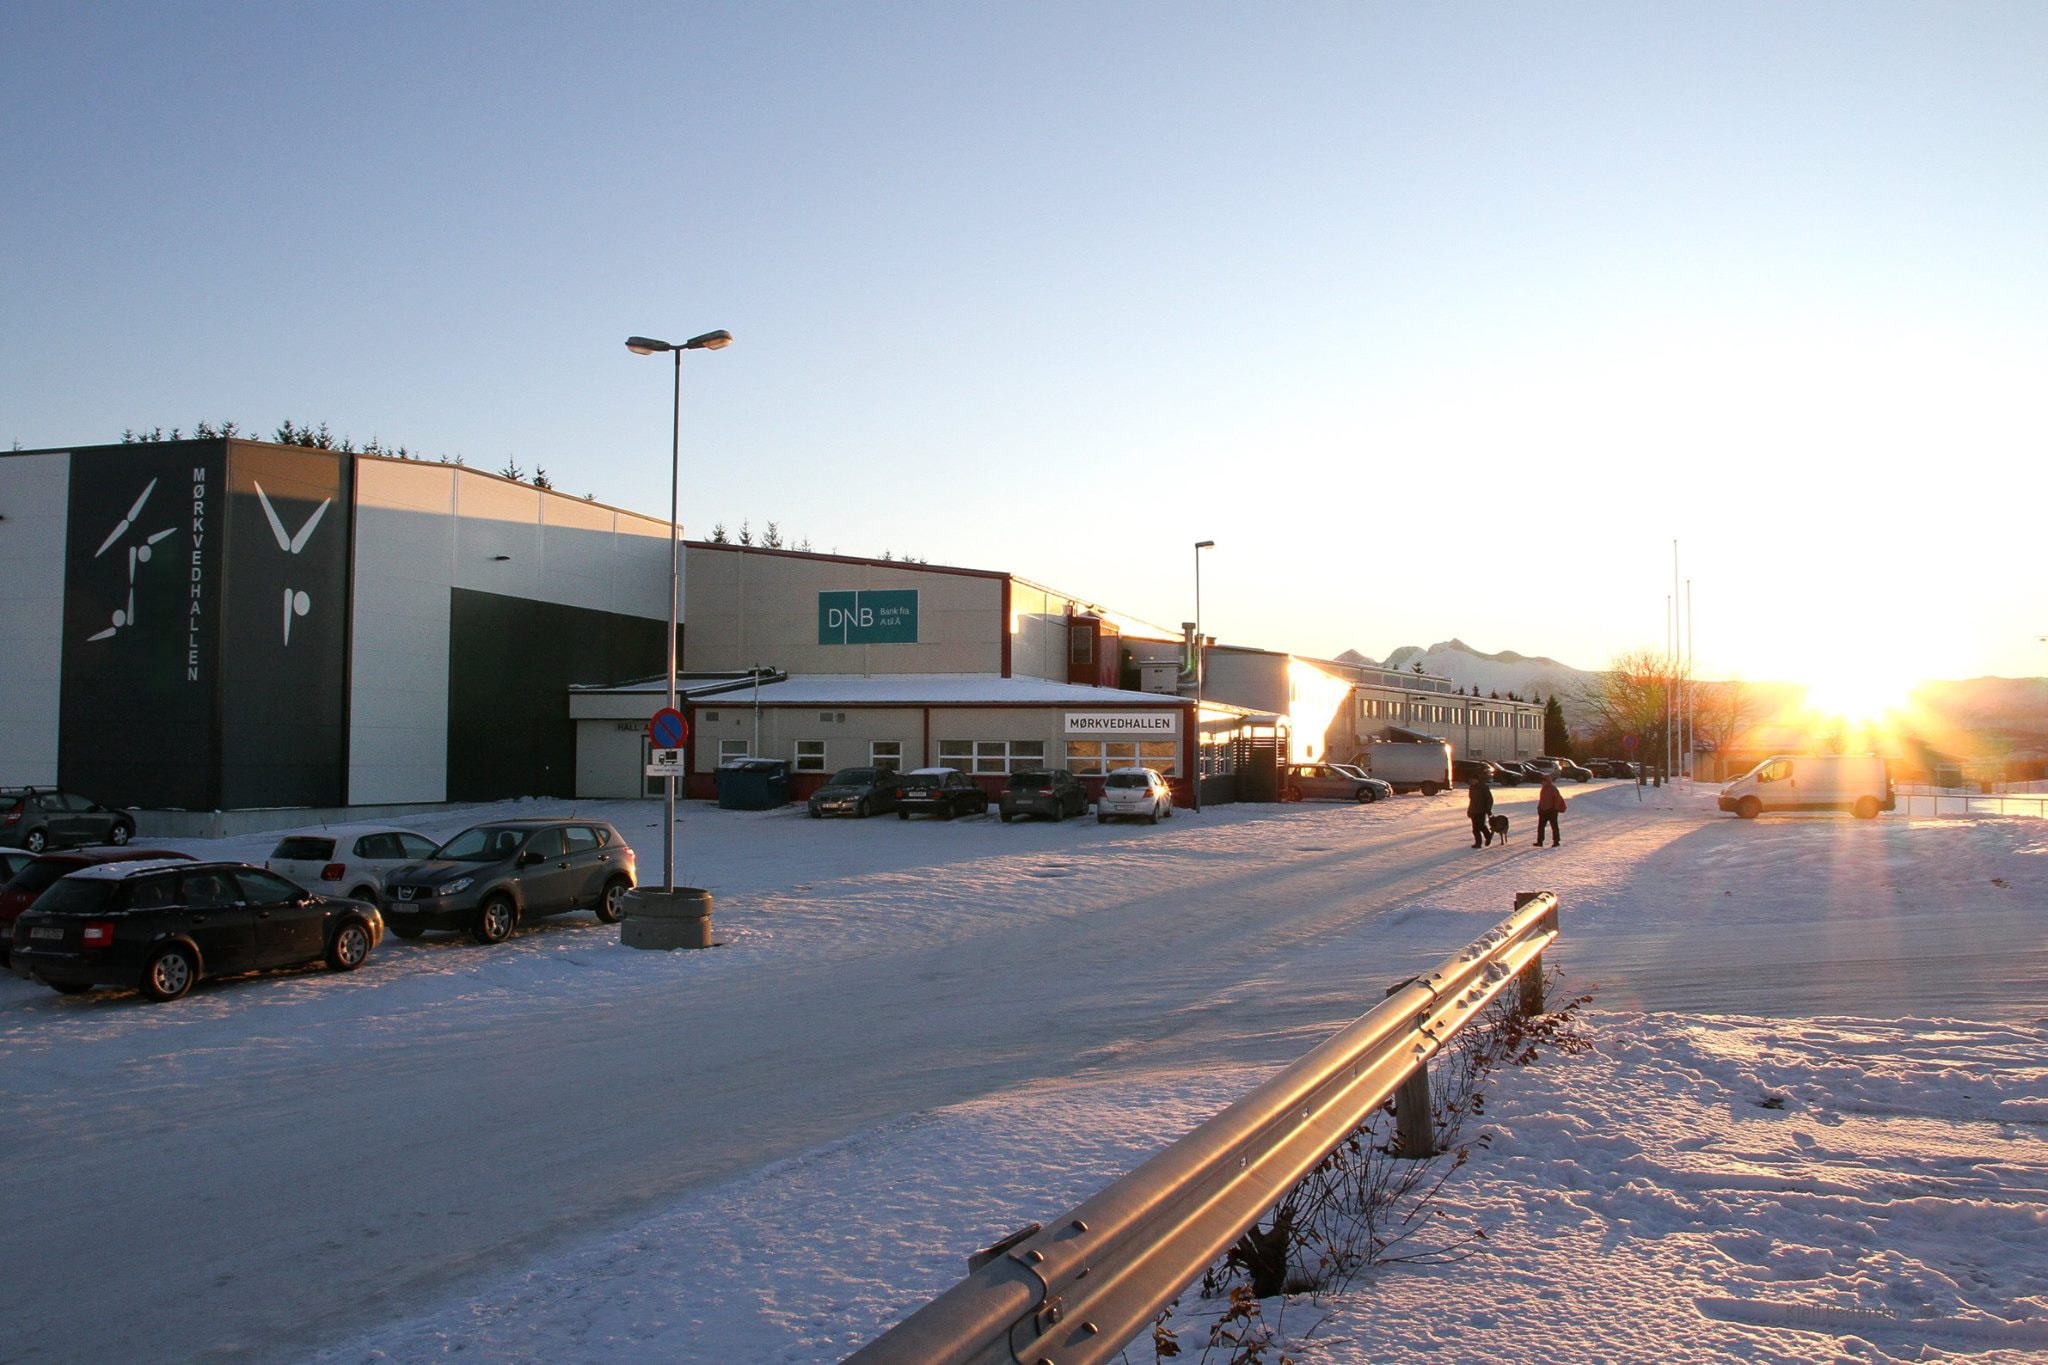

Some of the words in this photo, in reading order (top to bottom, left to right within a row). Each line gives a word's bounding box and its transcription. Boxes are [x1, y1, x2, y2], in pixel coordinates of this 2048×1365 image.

[187, 467, 206, 681] MØRKVEDHALLEN
[880, 607, 898, 616] Bank
[899, 606, 910, 615] fra
[617, 723, 639, 731] HALL
[1070, 718, 1170, 729] MØRKVEDHALLEN
